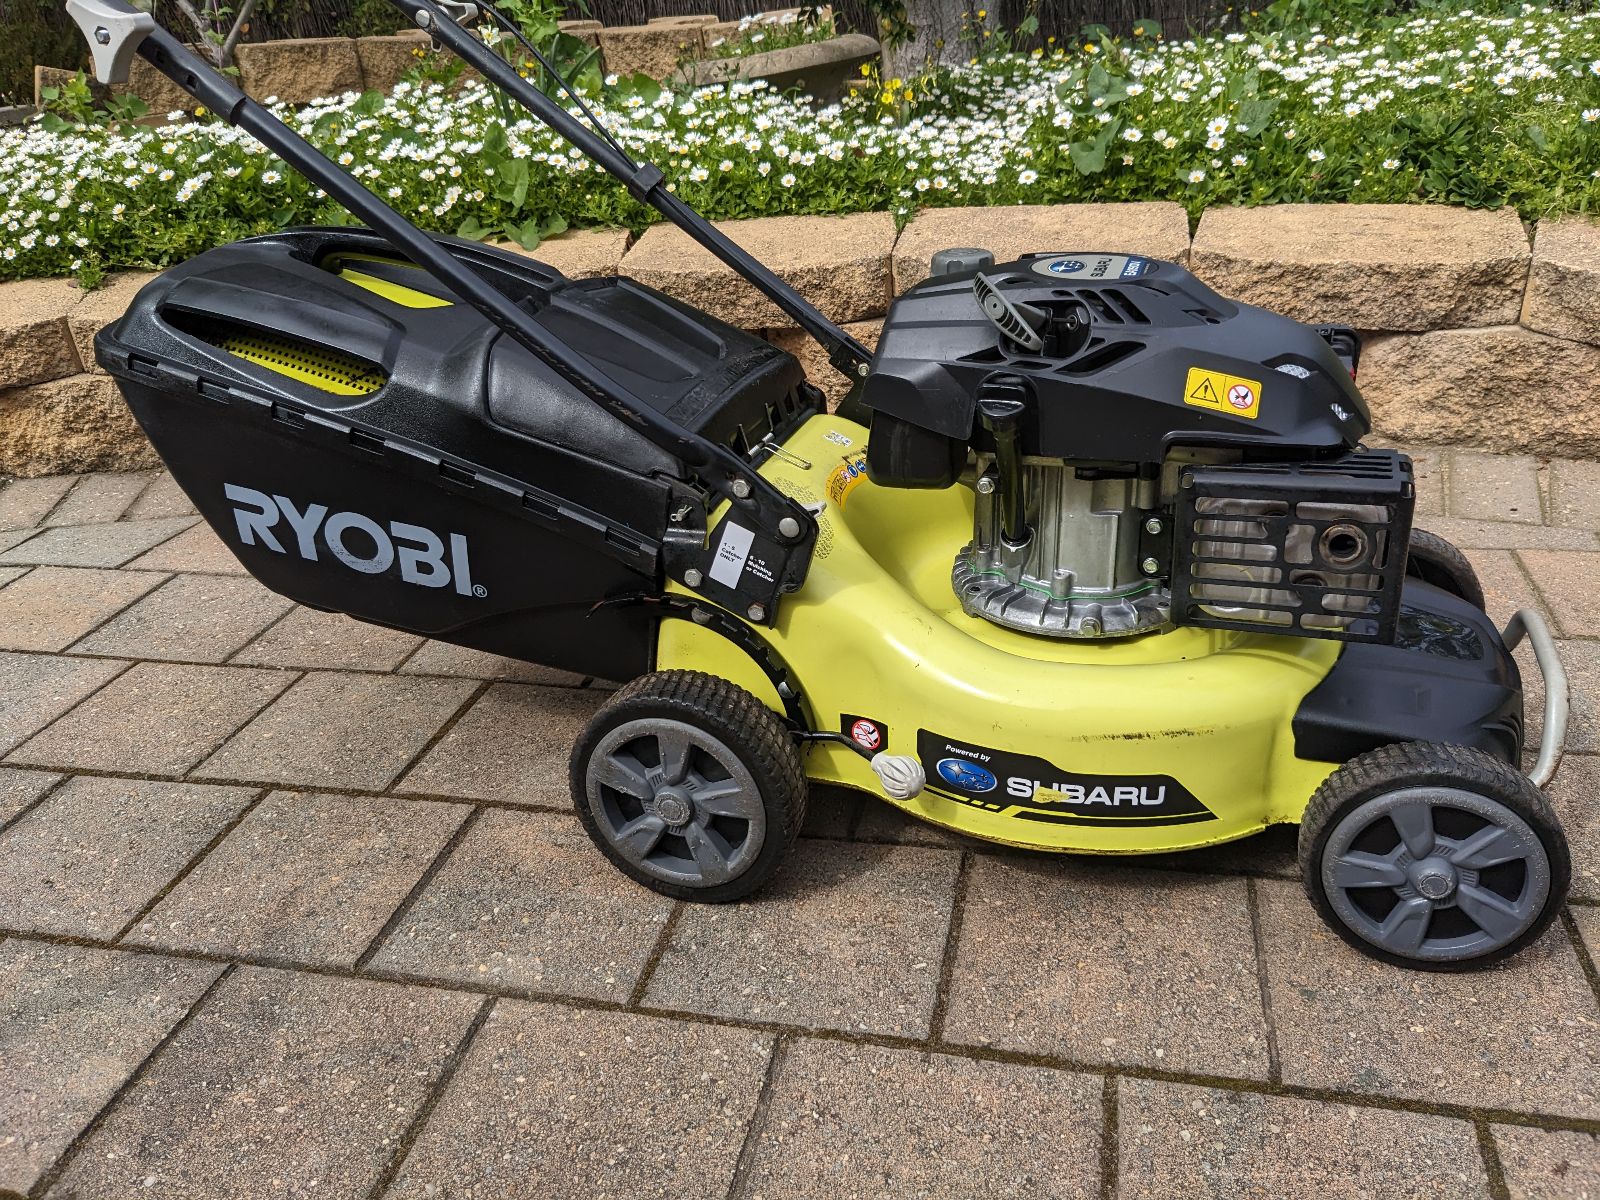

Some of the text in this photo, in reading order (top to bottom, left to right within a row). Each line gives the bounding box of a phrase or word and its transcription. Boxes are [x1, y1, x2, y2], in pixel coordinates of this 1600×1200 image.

[224, 483, 473, 597] RYOBI
[719, 552, 736, 563] ONLY
[721, 547, 743, 561] Catcher
[747, 560, 772, 577] Mulching
[752, 569, 775, 583] Catcher
[945, 744, 991, 762] Powered by
